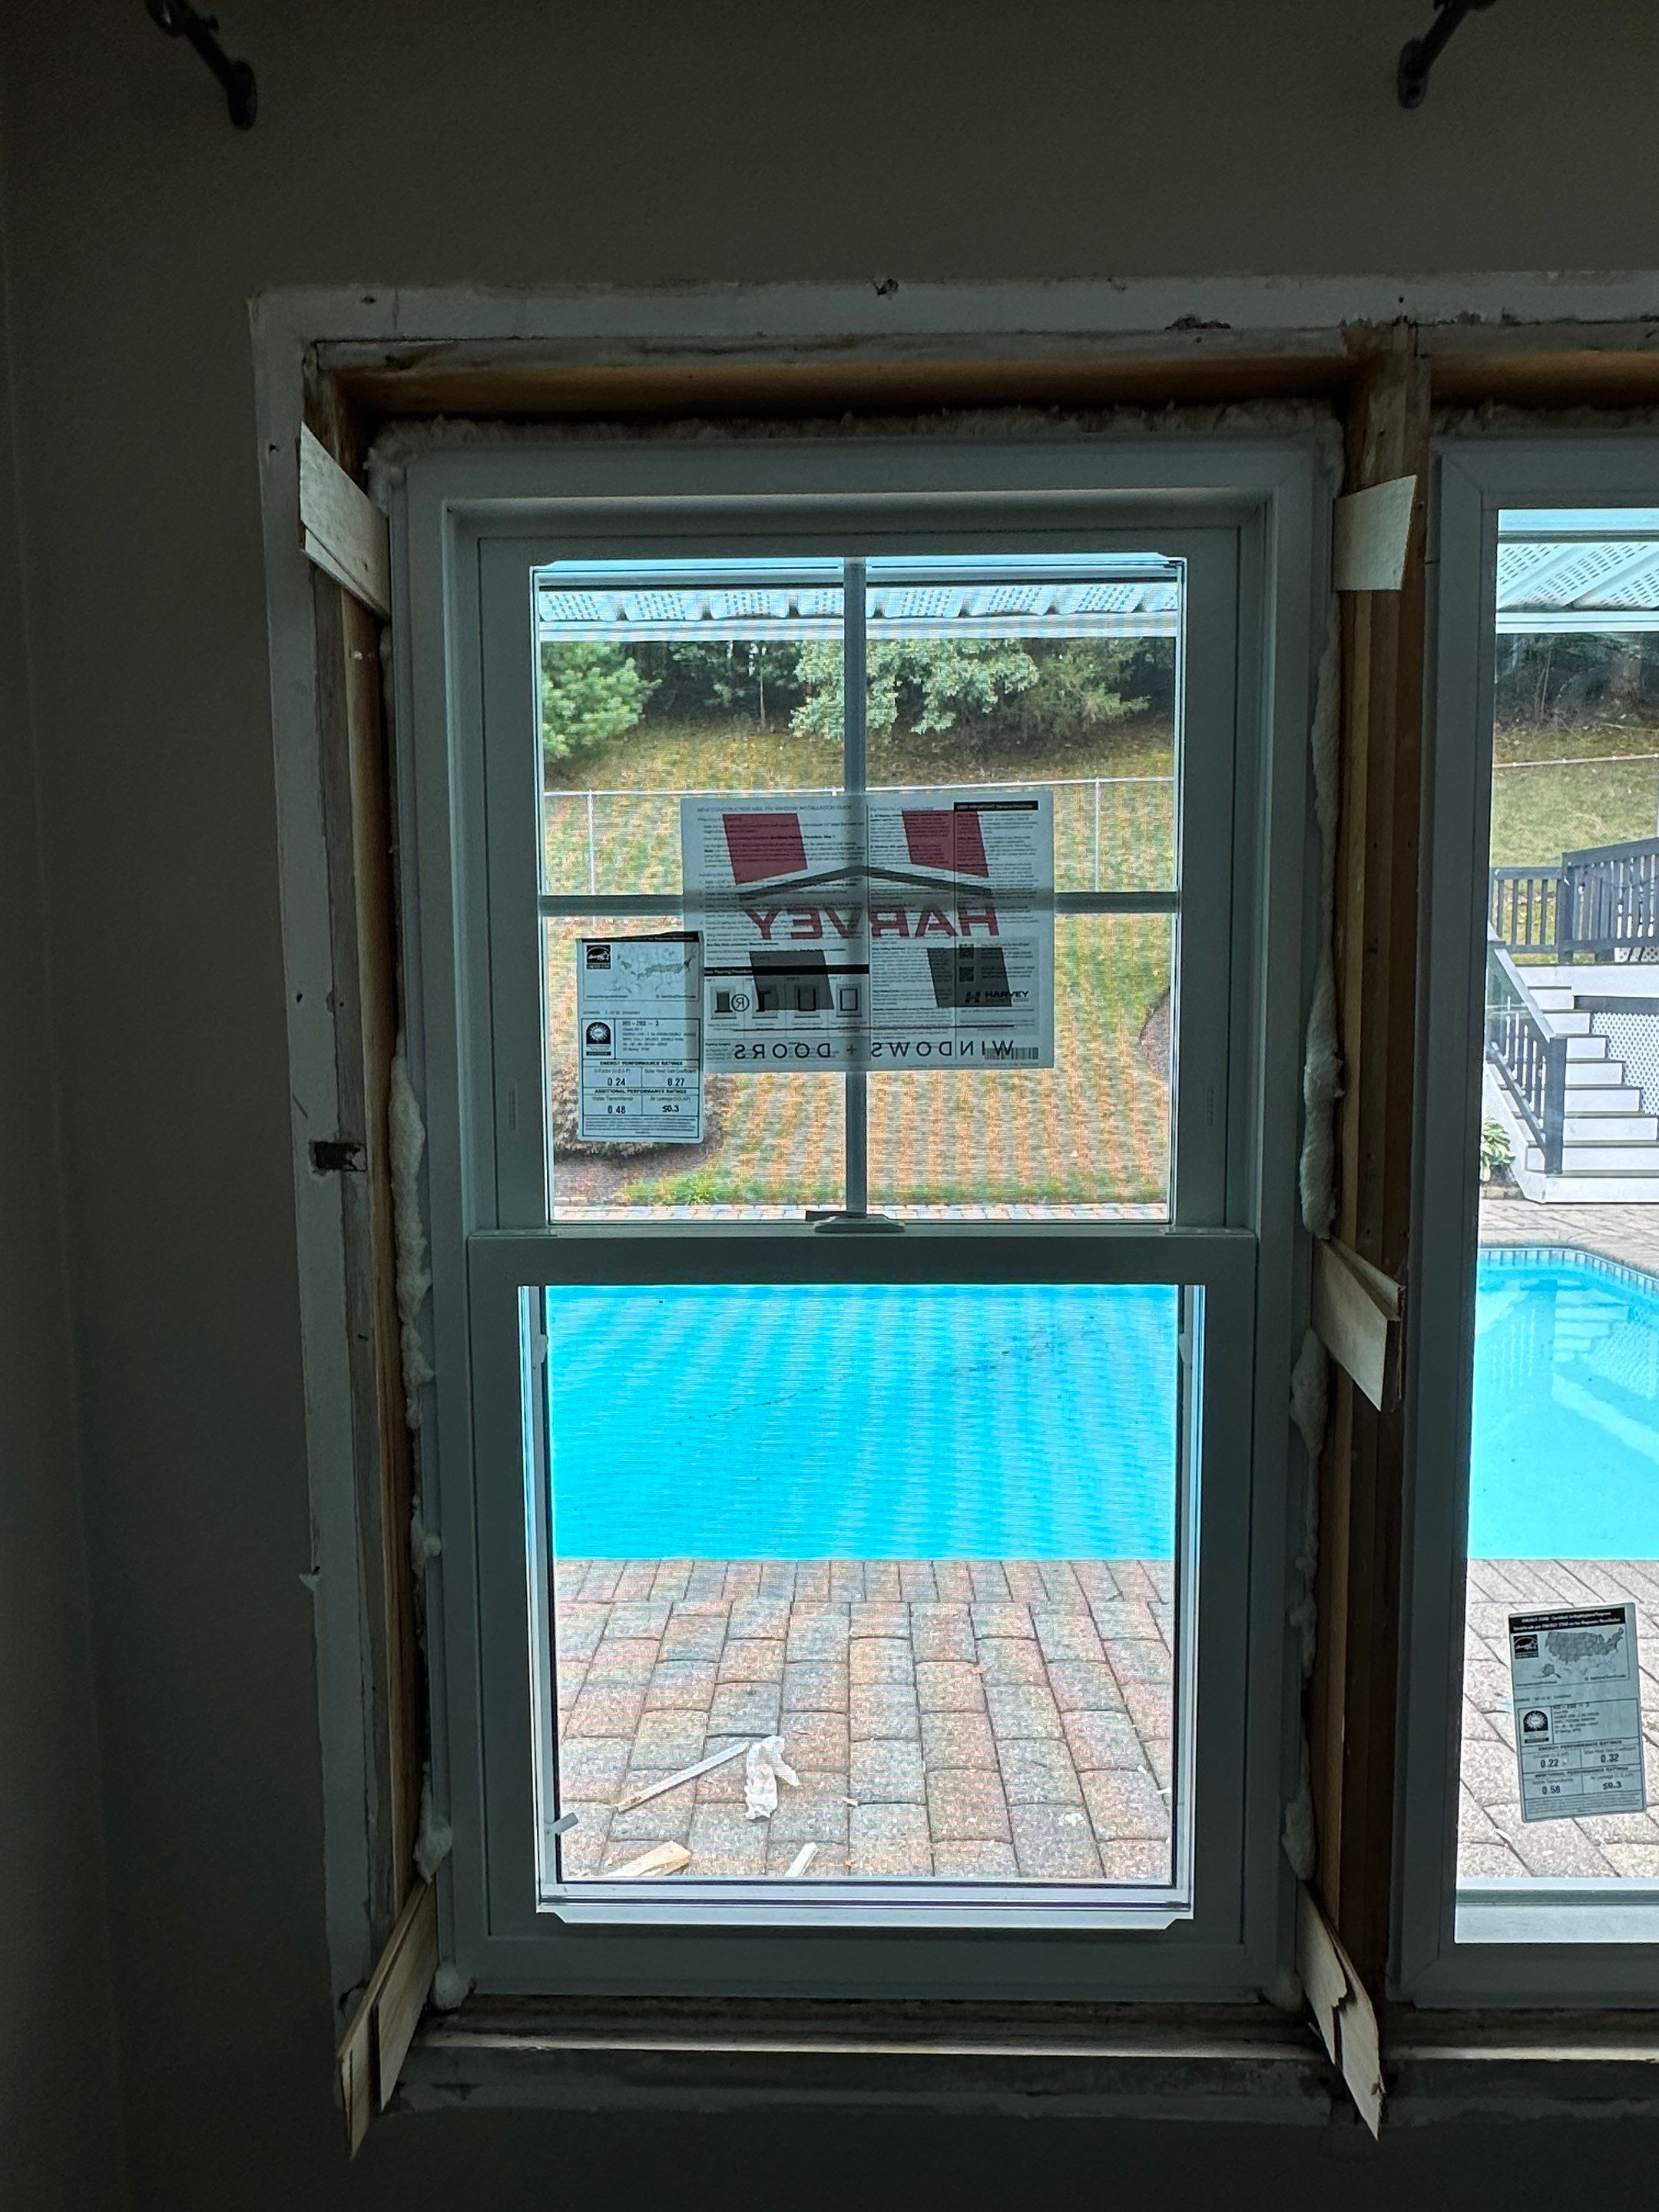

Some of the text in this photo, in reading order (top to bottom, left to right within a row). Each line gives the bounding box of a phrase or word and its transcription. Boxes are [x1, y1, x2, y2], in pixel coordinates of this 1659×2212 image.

[608, 1078, 626, 1086] 0.24
[667, 1078, 684, 1086] 0.27
[608, 1105, 626, 1114] 0.48
[1601, 1753, 1619, 1763] 0.32
[1540, 1759, 1559, 1768] 0.22
